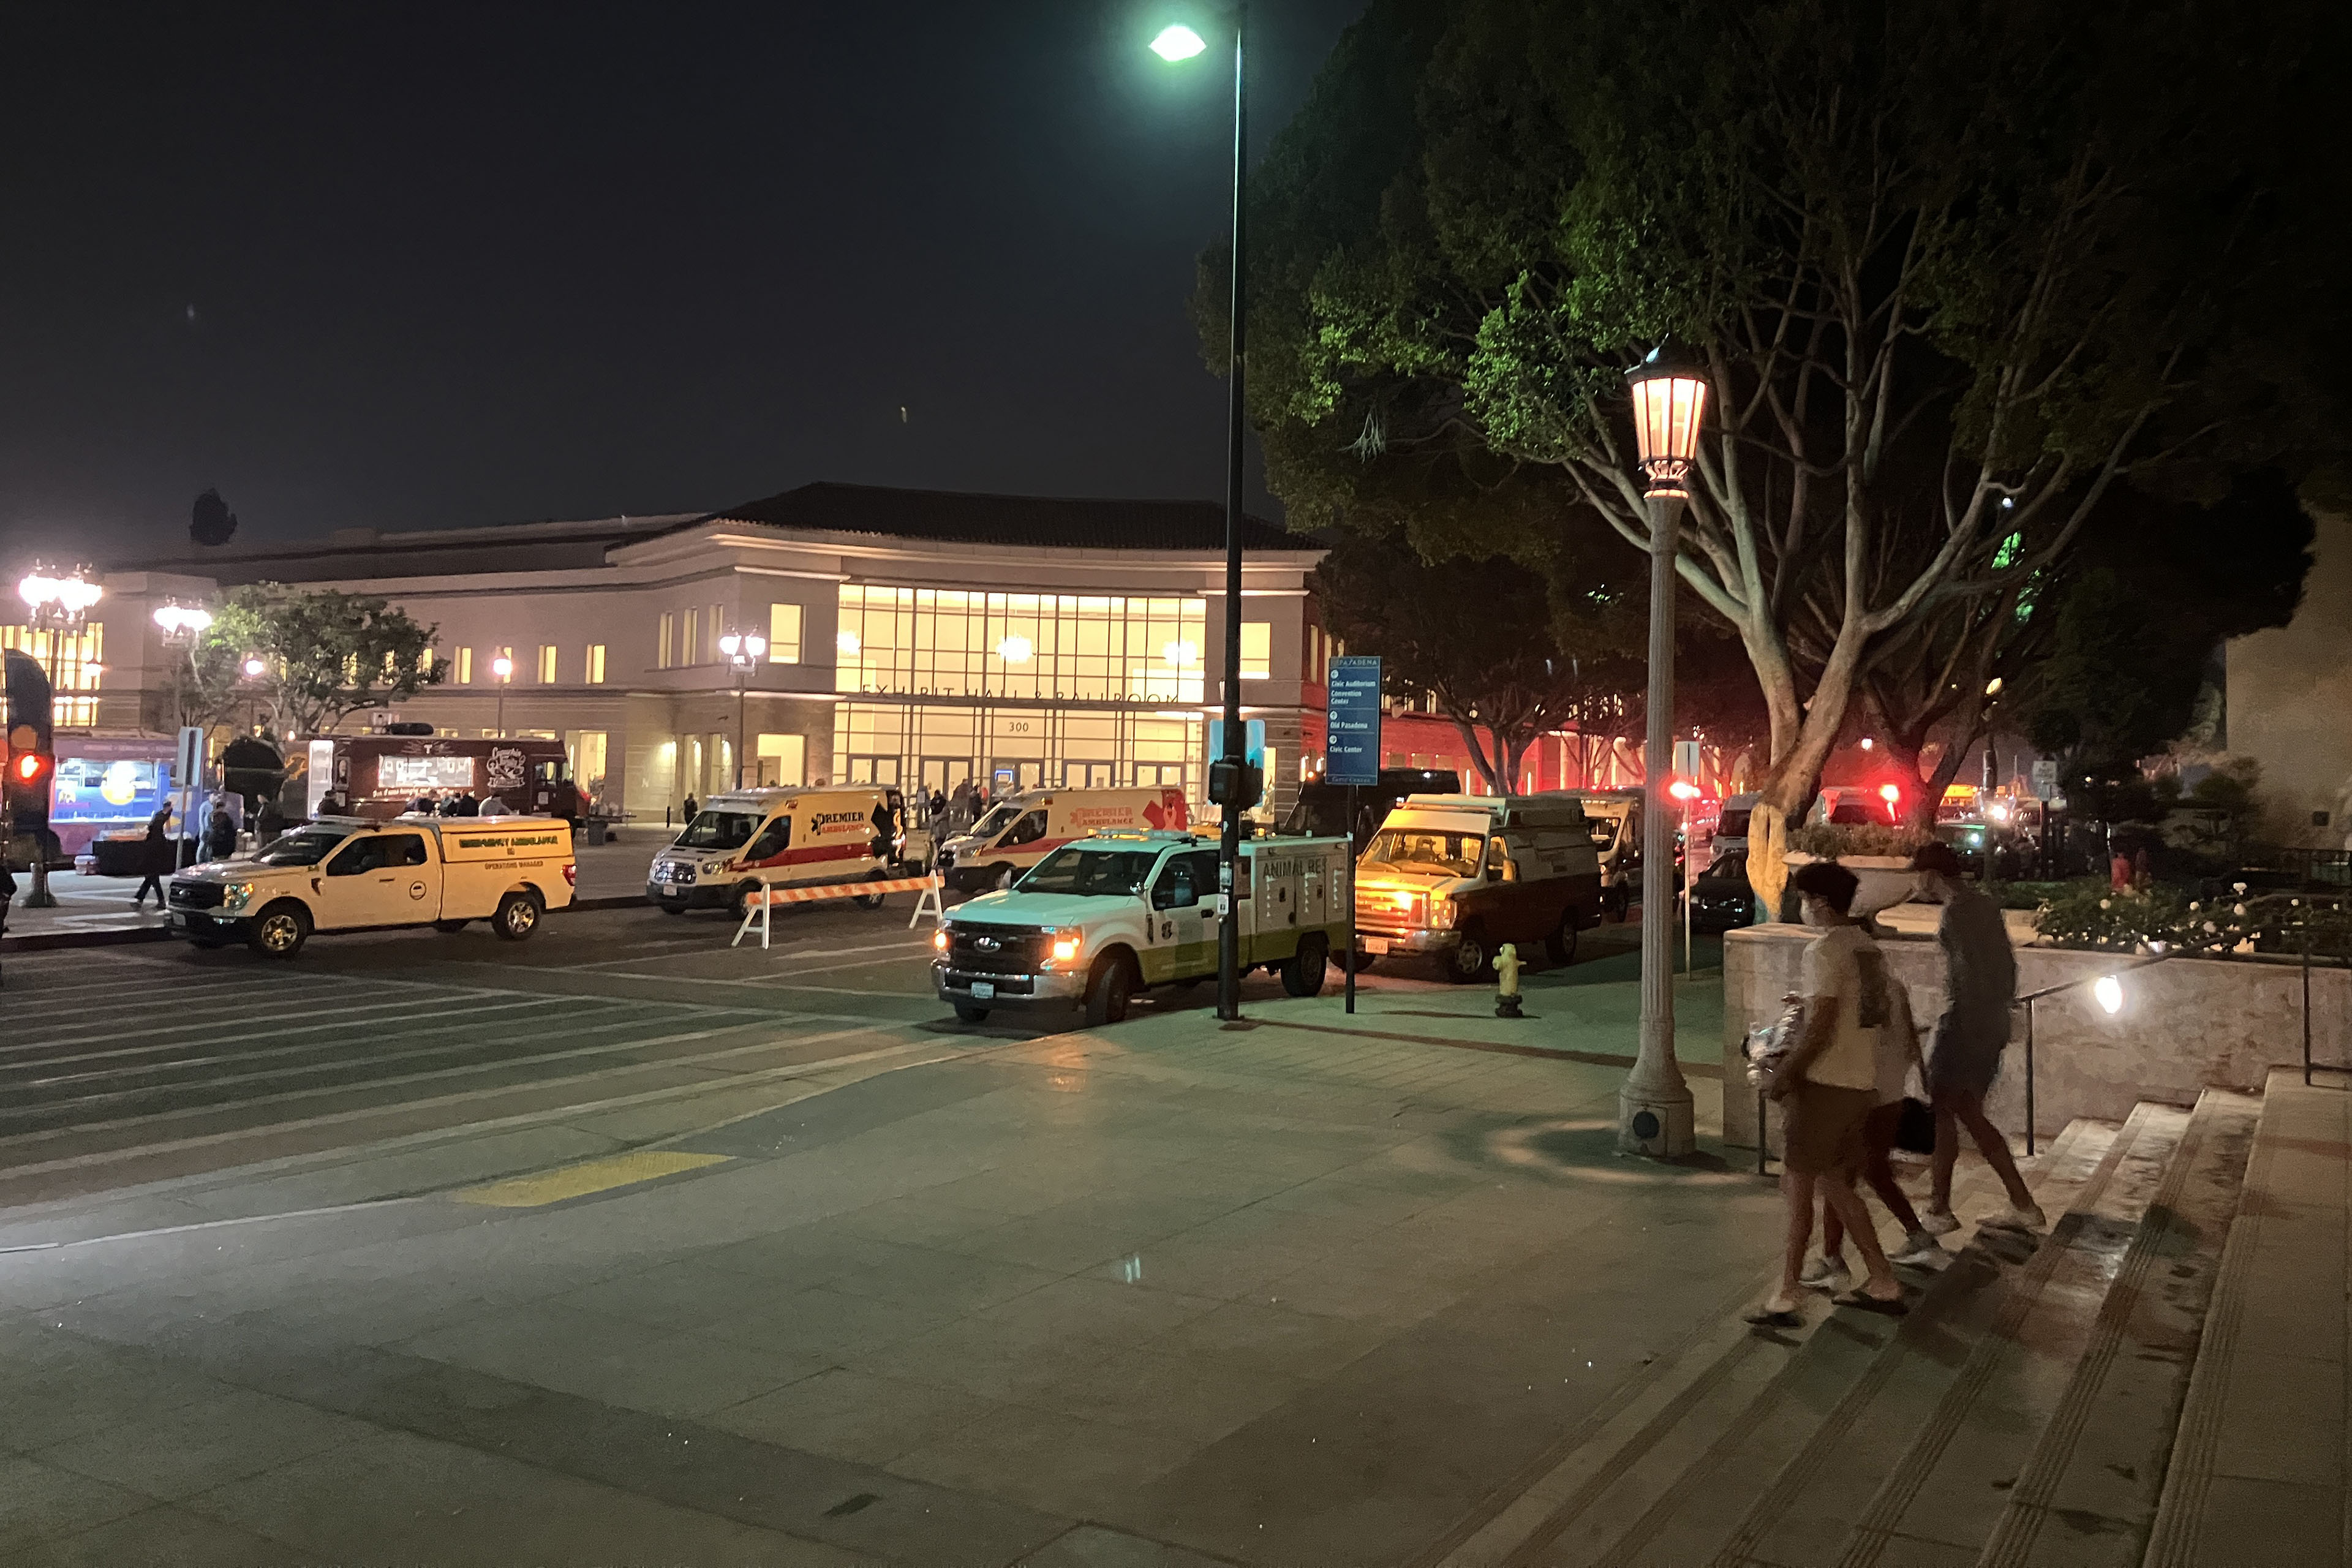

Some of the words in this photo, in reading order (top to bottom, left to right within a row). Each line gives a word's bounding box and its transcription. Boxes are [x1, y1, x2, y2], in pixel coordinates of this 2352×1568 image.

[1009, 722, 1029, 733] 300
[816, 812, 865, 835] PREMIER
[1082, 817, 1133, 826] AMBULANCE
[1263, 859, 1306, 878] ANIMAL
